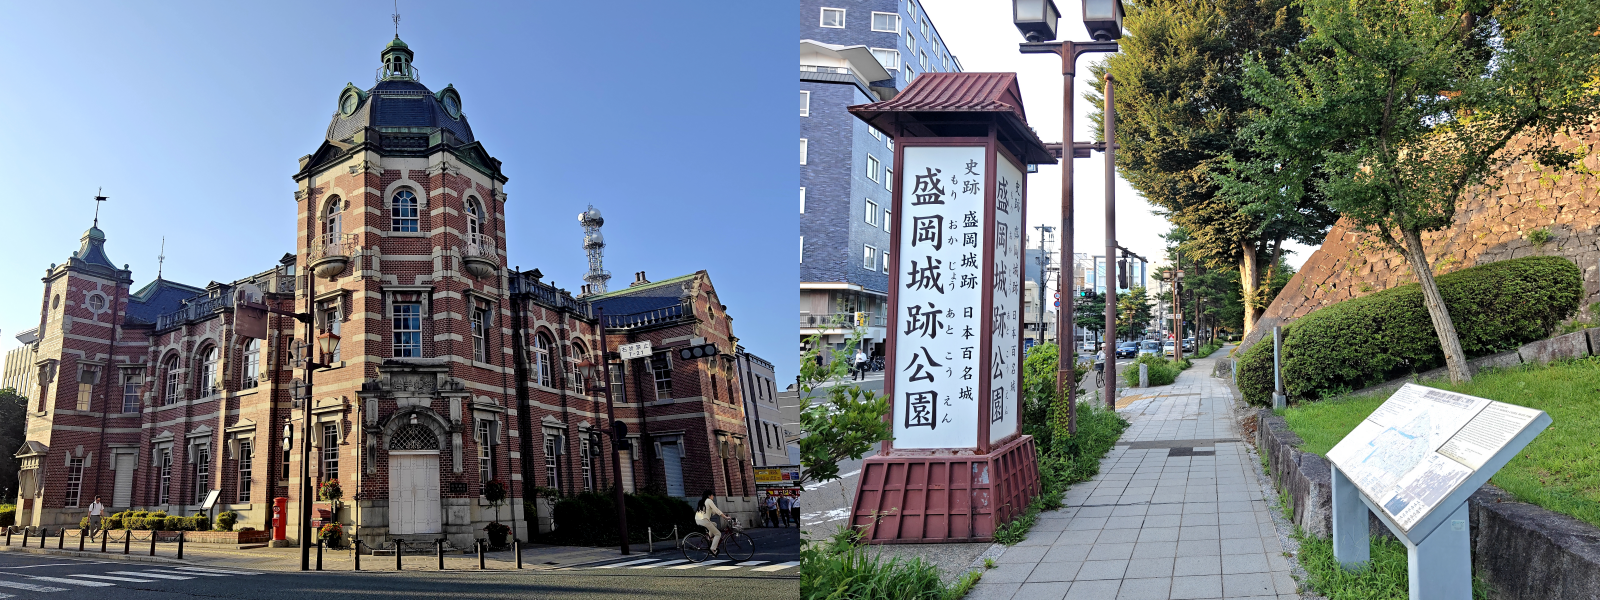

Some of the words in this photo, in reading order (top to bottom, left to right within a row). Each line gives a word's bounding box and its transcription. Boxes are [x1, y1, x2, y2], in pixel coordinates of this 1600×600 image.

[950, 174, 958, 200] もり
[962, 159, 980, 195] 史跡
[947, 220, 958, 245] おか
[960, 211, 979, 290] 盛岡城跡
[948, 261, 957, 291] じょう
[904, 167, 946, 430] 盛岡城跡公園
[992, 176, 1009, 425] 盛岡城跡公園
[945, 308, 955, 335] あと
[959, 306, 975, 401] 日本百名城
[941, 395, 952, 424] えん
